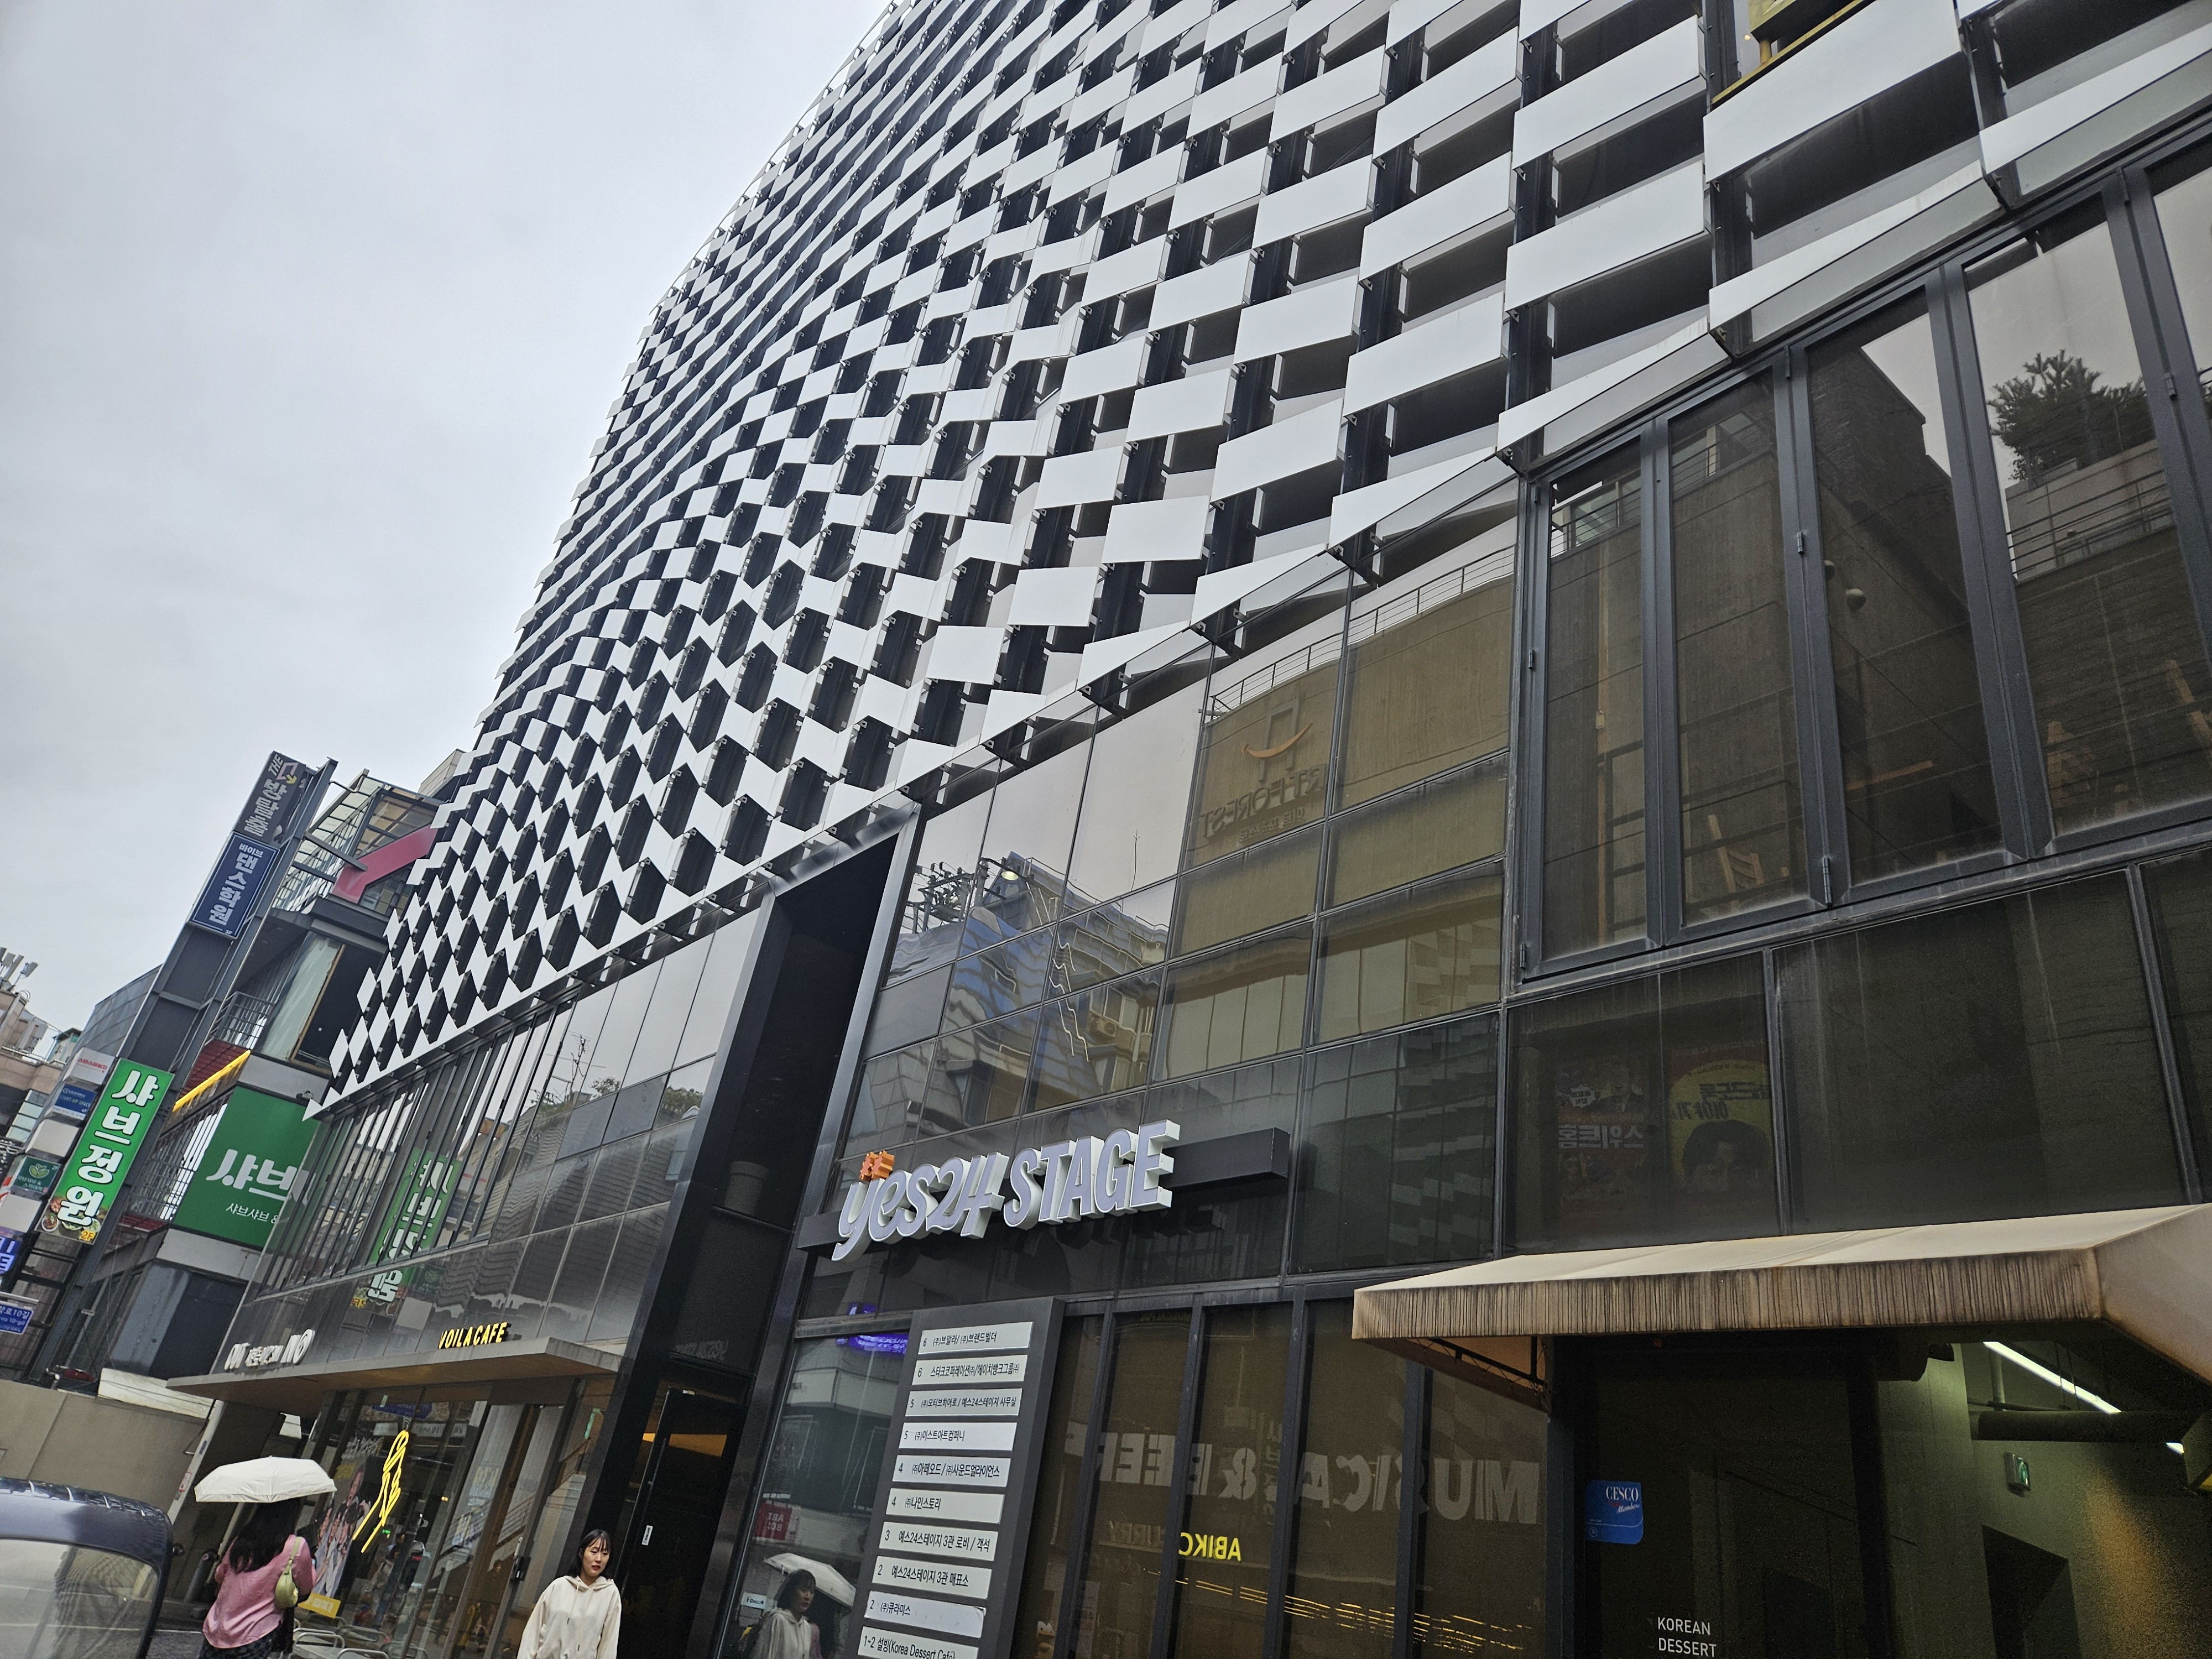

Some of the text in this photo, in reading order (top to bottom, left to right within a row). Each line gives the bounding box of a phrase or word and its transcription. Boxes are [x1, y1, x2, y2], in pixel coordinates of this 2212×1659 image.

[268, 753, 284, 776] THE
[244, 778, 288, 837] 방탈출
[239, 843, 264, 858] 바이브
[209, 852, 258, 926] 댄스학원
[57, 1070, 159, 1227] 샤브정원
[832, 1119, 1180, 1261] yes24 STAGE
[226, 1203, 270, 1222] 샤브샤브
[80, 1230, 96, 1241] 2F
[439, 1322, 508, 1349] VOILA CAFE
[923, 1338, 927, 1347] 6
[918, 1368, 922, 1377] 6
[910, 1399, 914, 1408] 5
[962, 1397, 999, 1407] 예스24스테이지
[1000, 1397, 1016, 1407] 사무실
[904, 1431, 909, 1439] 5
[898, 1463, 903, 1473] 4
[891, 1496, 896, 1507] 4
[1606, 1486, 1639, 1501] CESCO
[885, 1530, 990, 1552] 3 예스24스테이지 3관 로비 / 객석
[878, 1564, 969, 1587] 2 예스24스테이지 3관 매표소
[870, 1600, 911, 1616] 2 (주)큐라미스
[1658, 1616, 1710, 1636] KOREAN
[864, 1635, 875, 1648] 1~2
[877, 1637, 908, 1656] 설빙(Korea
[910, 1644, 936, 1659] Dessert
[1659, 1637, 1717, 1658] DESSERT
